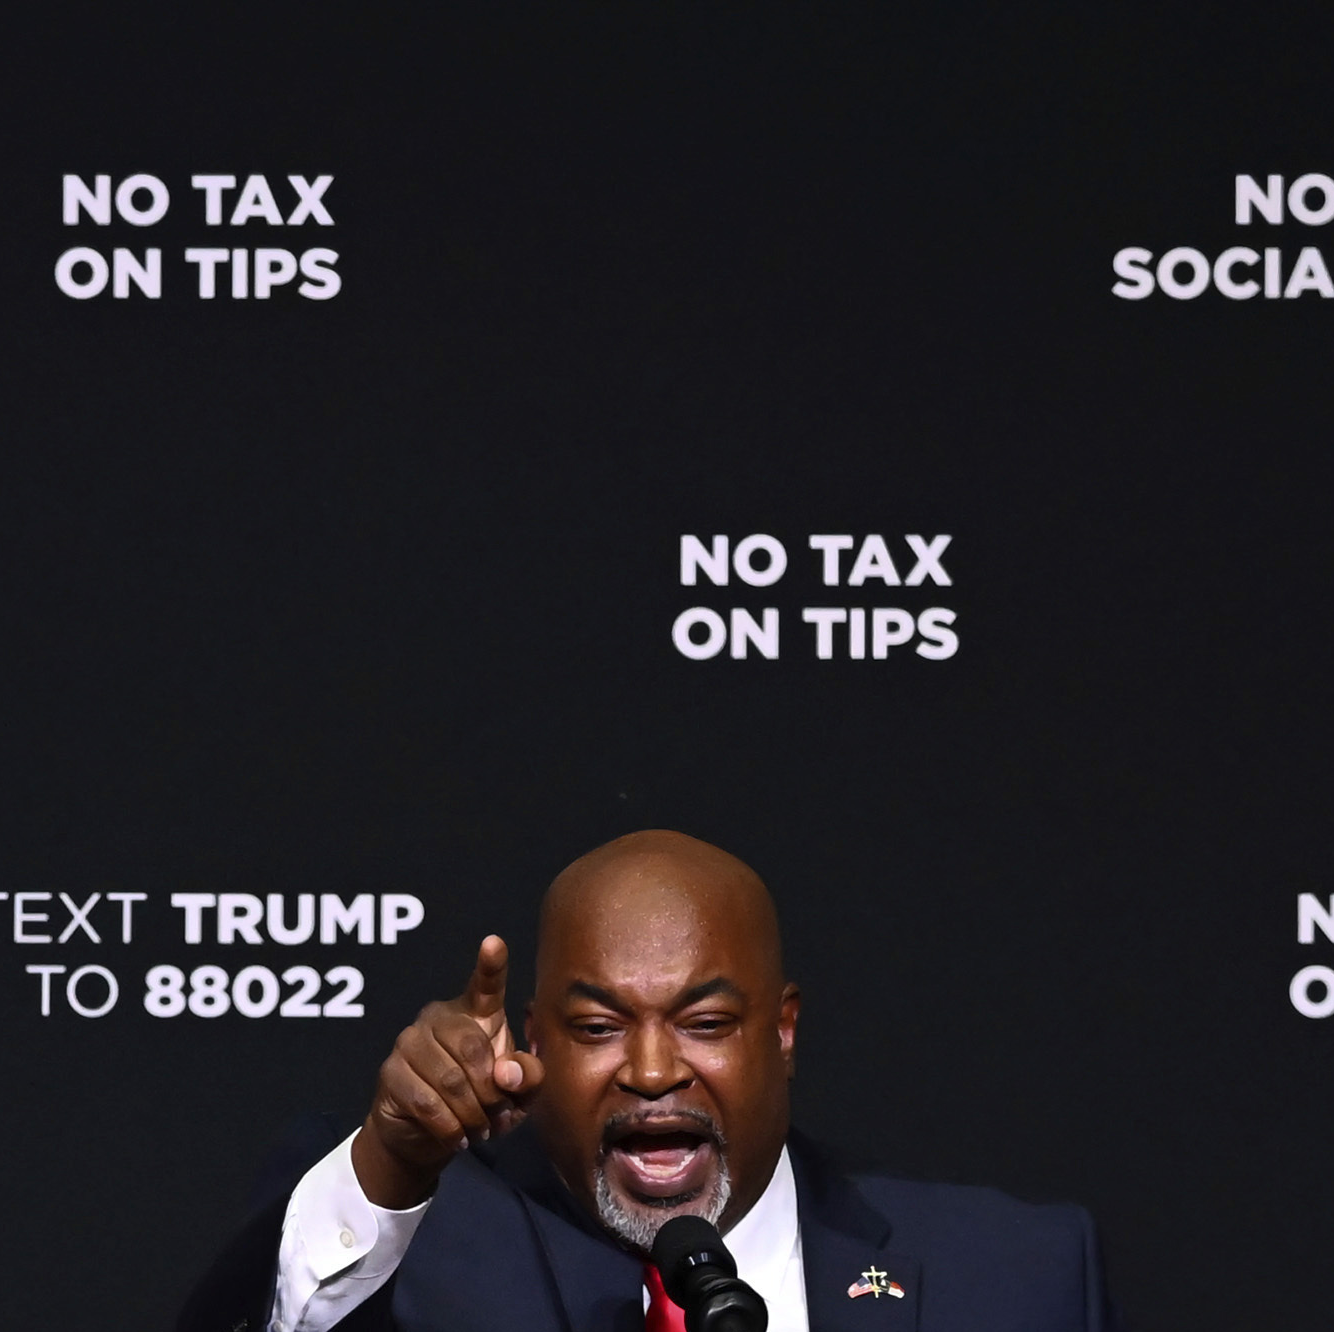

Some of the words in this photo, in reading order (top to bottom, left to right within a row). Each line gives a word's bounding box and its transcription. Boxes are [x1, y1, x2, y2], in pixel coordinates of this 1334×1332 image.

[63, 174, 169, 226] NO
[192, 174, 334, 226] TAX
[55, 247, 161, 299] ON
[185, 247, 341, 299] TIPS
[681, 534, 787, 586] NO
[809, 534, 951, 586] TAX
[672, 607, 779, 660] ON
[803, 607, 958, 660] TIPS
[171, 892, 424, 945] TRUMP
[26, 965, 118, 1018] TO
[144, 965, 364, 1018] 88022
